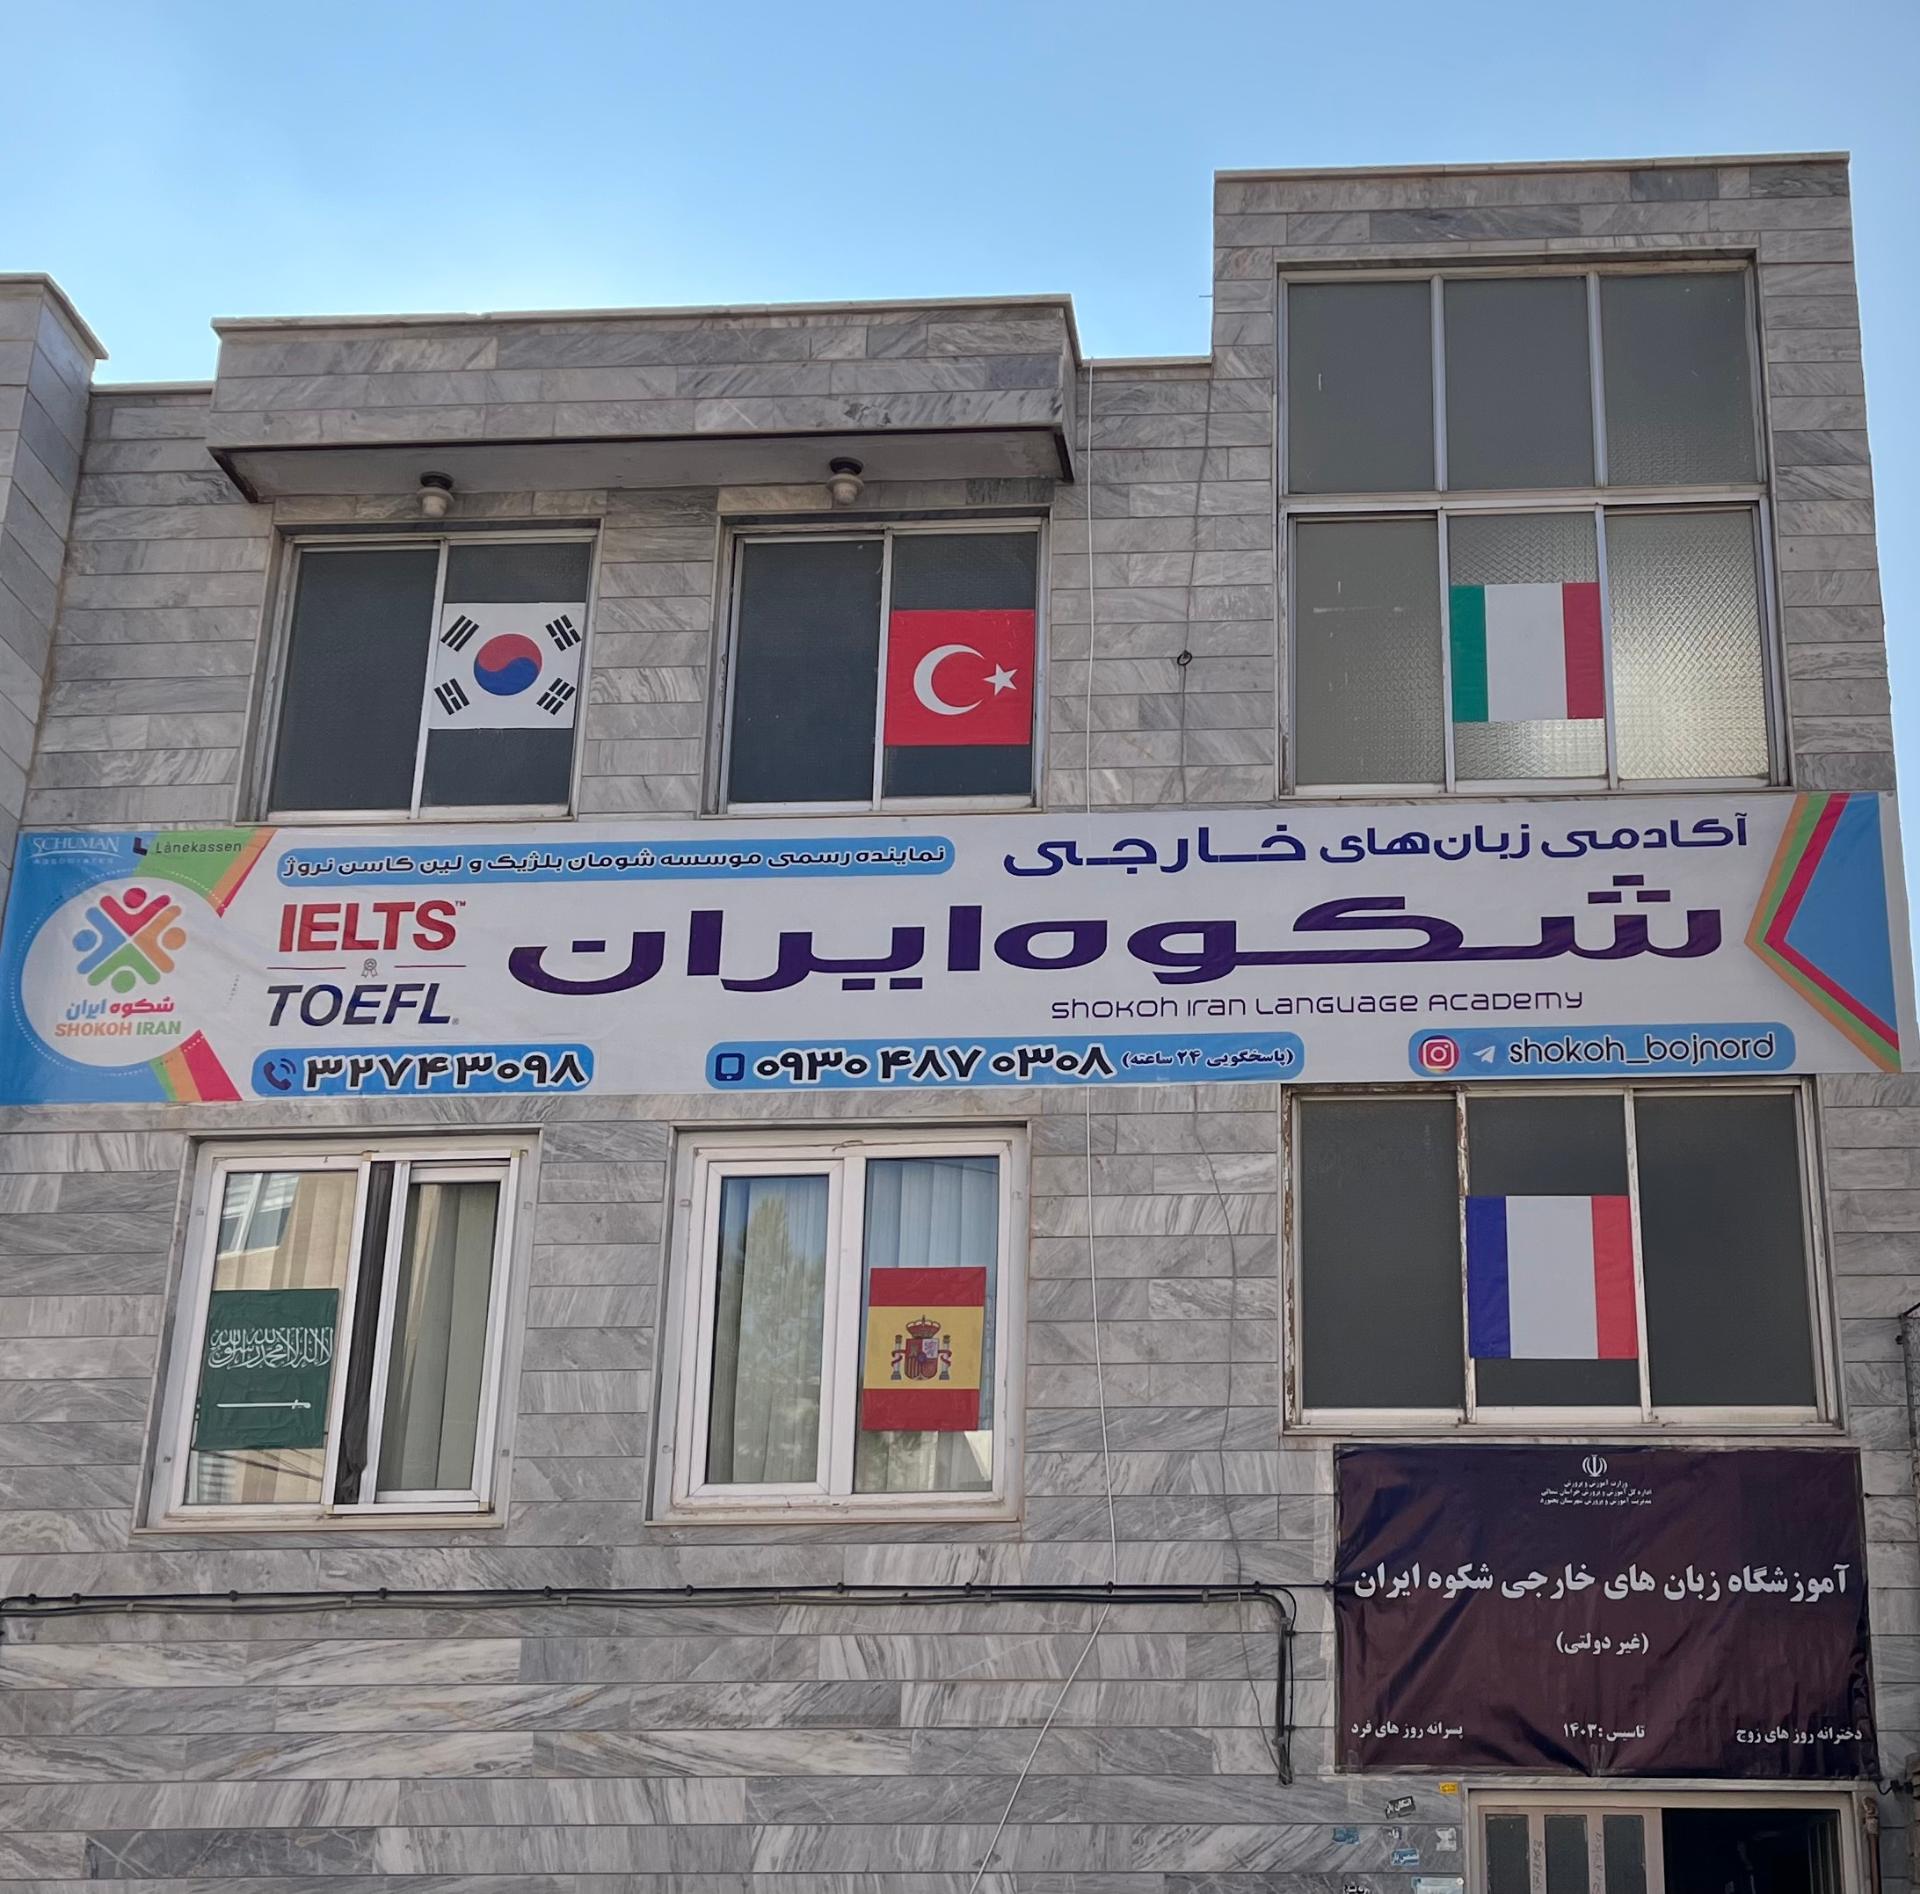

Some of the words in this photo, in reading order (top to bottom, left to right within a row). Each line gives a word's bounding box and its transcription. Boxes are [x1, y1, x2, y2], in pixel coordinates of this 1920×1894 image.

[32, 837, 119, 853] SCHUMAN
[1541, 812, 1748, 858] آکادمی
[155, 840, 242, 854] Lånekassen
[855, 846, 944, 867] نماینده
[1003, 824, 1307, 877] خارجی
[284, 857, 334, 876] نروژ
[338, 857, 414, 875] کاسن
[420, 856, 462, 874] لین
[469, 858, 482, 873] و
[487, 852, 563, 872] بلژیک
[567, 848, 655, 871] شومان
[660, 851, 762, 869] موسسه
[768, 850, 851, 869] رسمی
[994, 875, 1722, 985] شکوه
[507, 905, 982, 996] ایران
[65, 998, 107, 1021] ایران
[109, 996, 175, 1018] شکوه
[54, 1022, 132, 1037] SHOKOH
[136, 1021, 181, 1035] IRAN
[1177, 1050, 1201, 1065] ۲۴
[1508, 1033, 1774, 1065] shokoh_bojnord
[306, 1054, 586, 1089] ۳۲۷۴۳۰۹۸
[757, 1050, 868, 1081] ۰۹۳۰
[880, 1049, 982, 1079] ۴۸۷
[992, 1046, 1114, 1077] ۰۳۰۸
[1354, 1562, 1420, 1598] ایران
[1428, 1563, 1494, 1598] شکوه
[1502, 1562, 1596, 1599] خارجی
[1603, 1563, 1656, 1600] های
[1664, 1564, 1721, 1601] زبان
[1728, 1564, 1850, 1602] آموزشگاه
[1350, 1720, 1372, 1738] فرد
[1375, 1720, 1399, 1738] های
[1402, 1721, 1424, 1739] روز
[1427, 1720, 1464, 1739] پسرانه
[1606, 1722, 1645, 1742] تاسیس
[1736, 1727, 1761, 1744] زوج
[1764, 1726, 1790, 1744] های
[1793, 1727, 1815, 1744] روز
[1817, 1726, 1863, 1744] دخترانه
